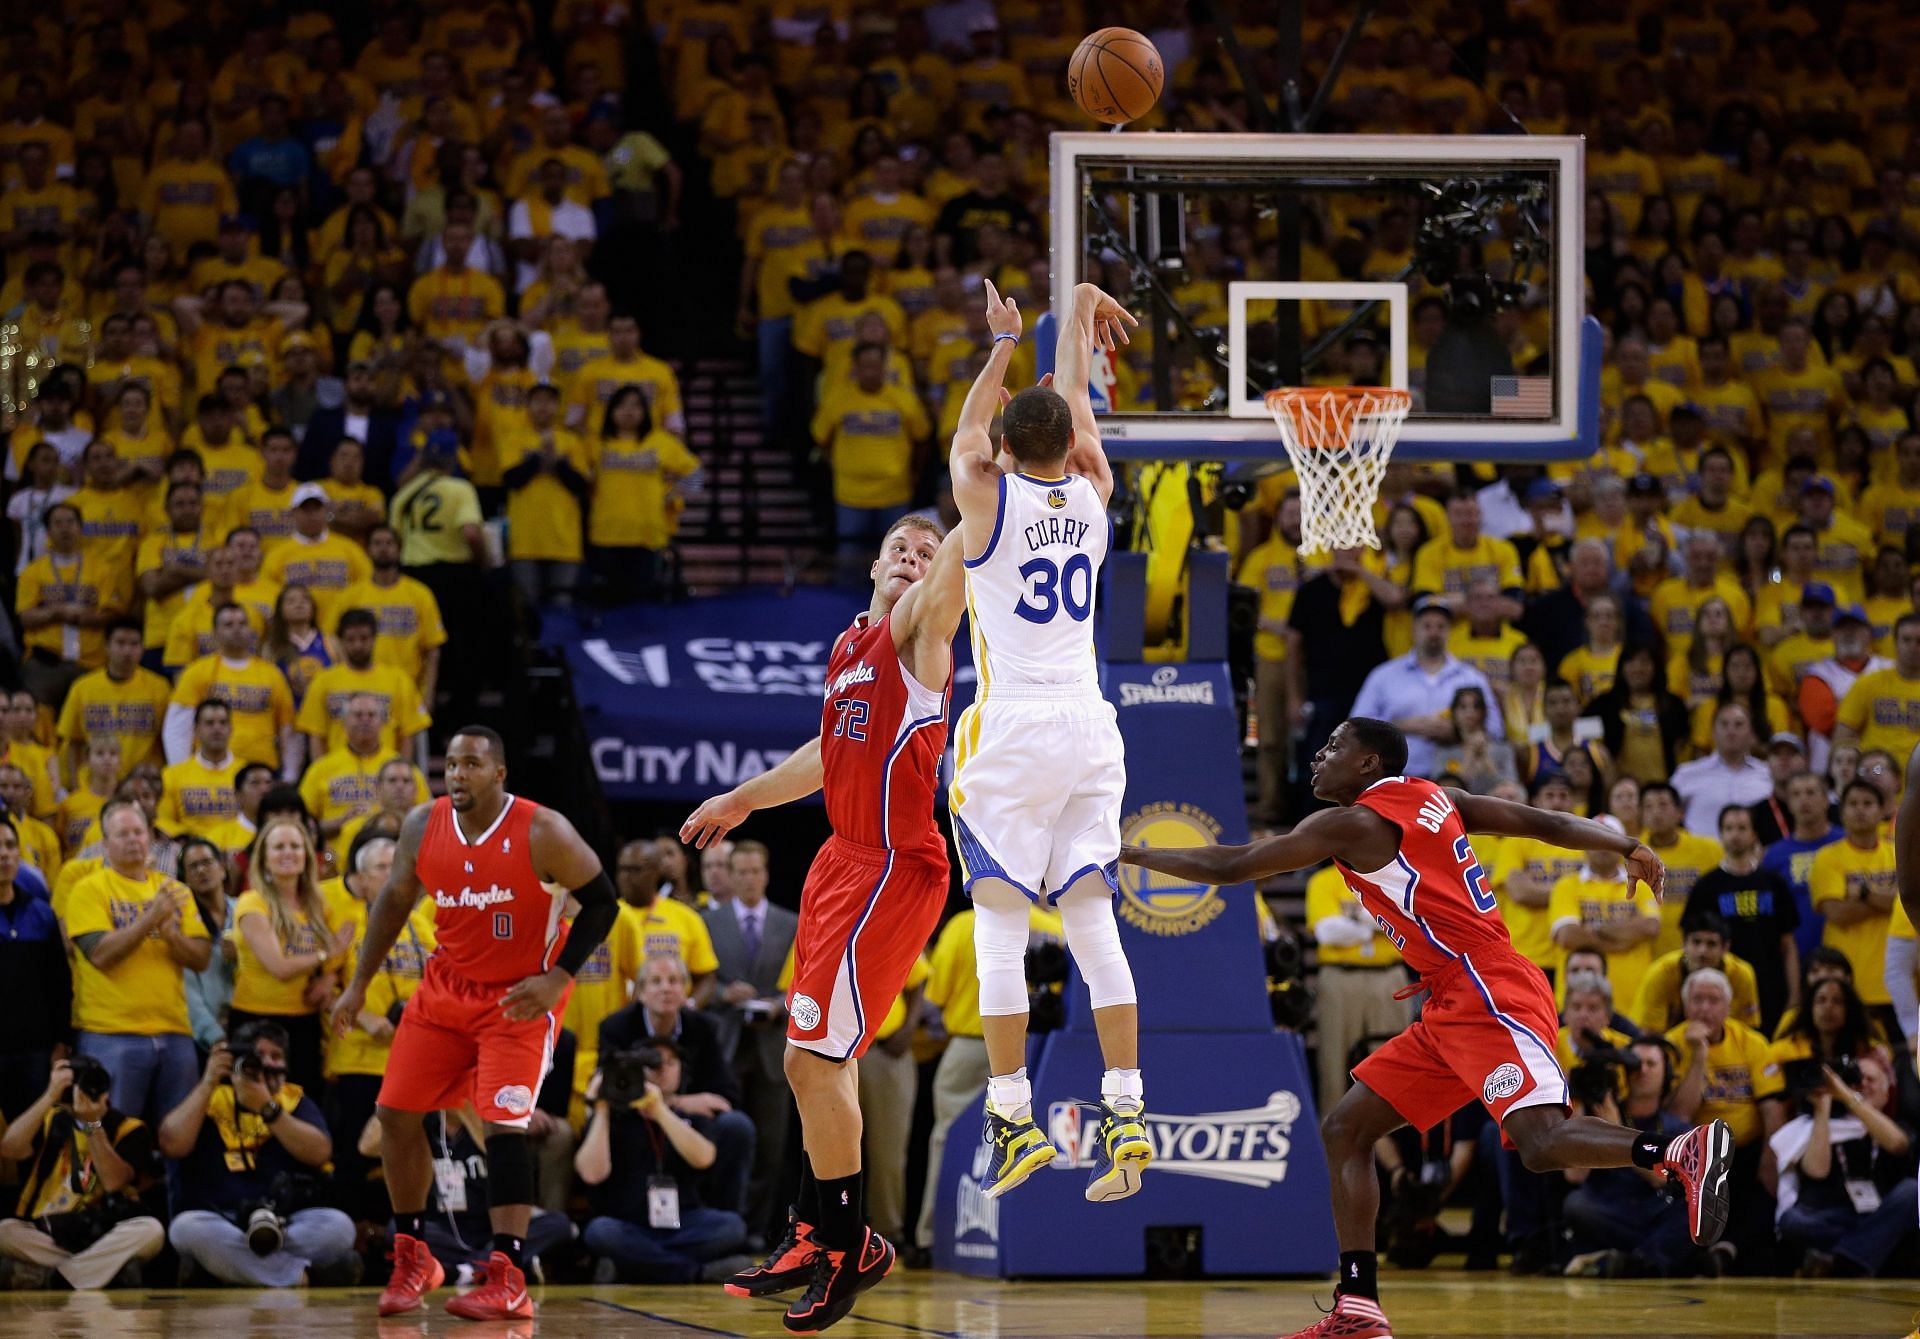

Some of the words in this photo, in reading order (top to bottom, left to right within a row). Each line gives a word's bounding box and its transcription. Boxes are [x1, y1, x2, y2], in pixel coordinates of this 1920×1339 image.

[1024, 517, 1090, 551] CURRY
[1013, 553, 1092, 625] 30
[685, 637, 826, 663] CITY
[1119, 680, 1214, 707] SPALDING
[834, 698, 870, 742] 32
[591, 736, 692, 785] CITY
[1416, 789, 1456, 834] COLLI
[1453, 832, 1497, 914] 2
[459, 883, 515, 912] Angeles
[1118, 895, 1228, 937] WARRIORS
[492, 912, 513, 940] 0
